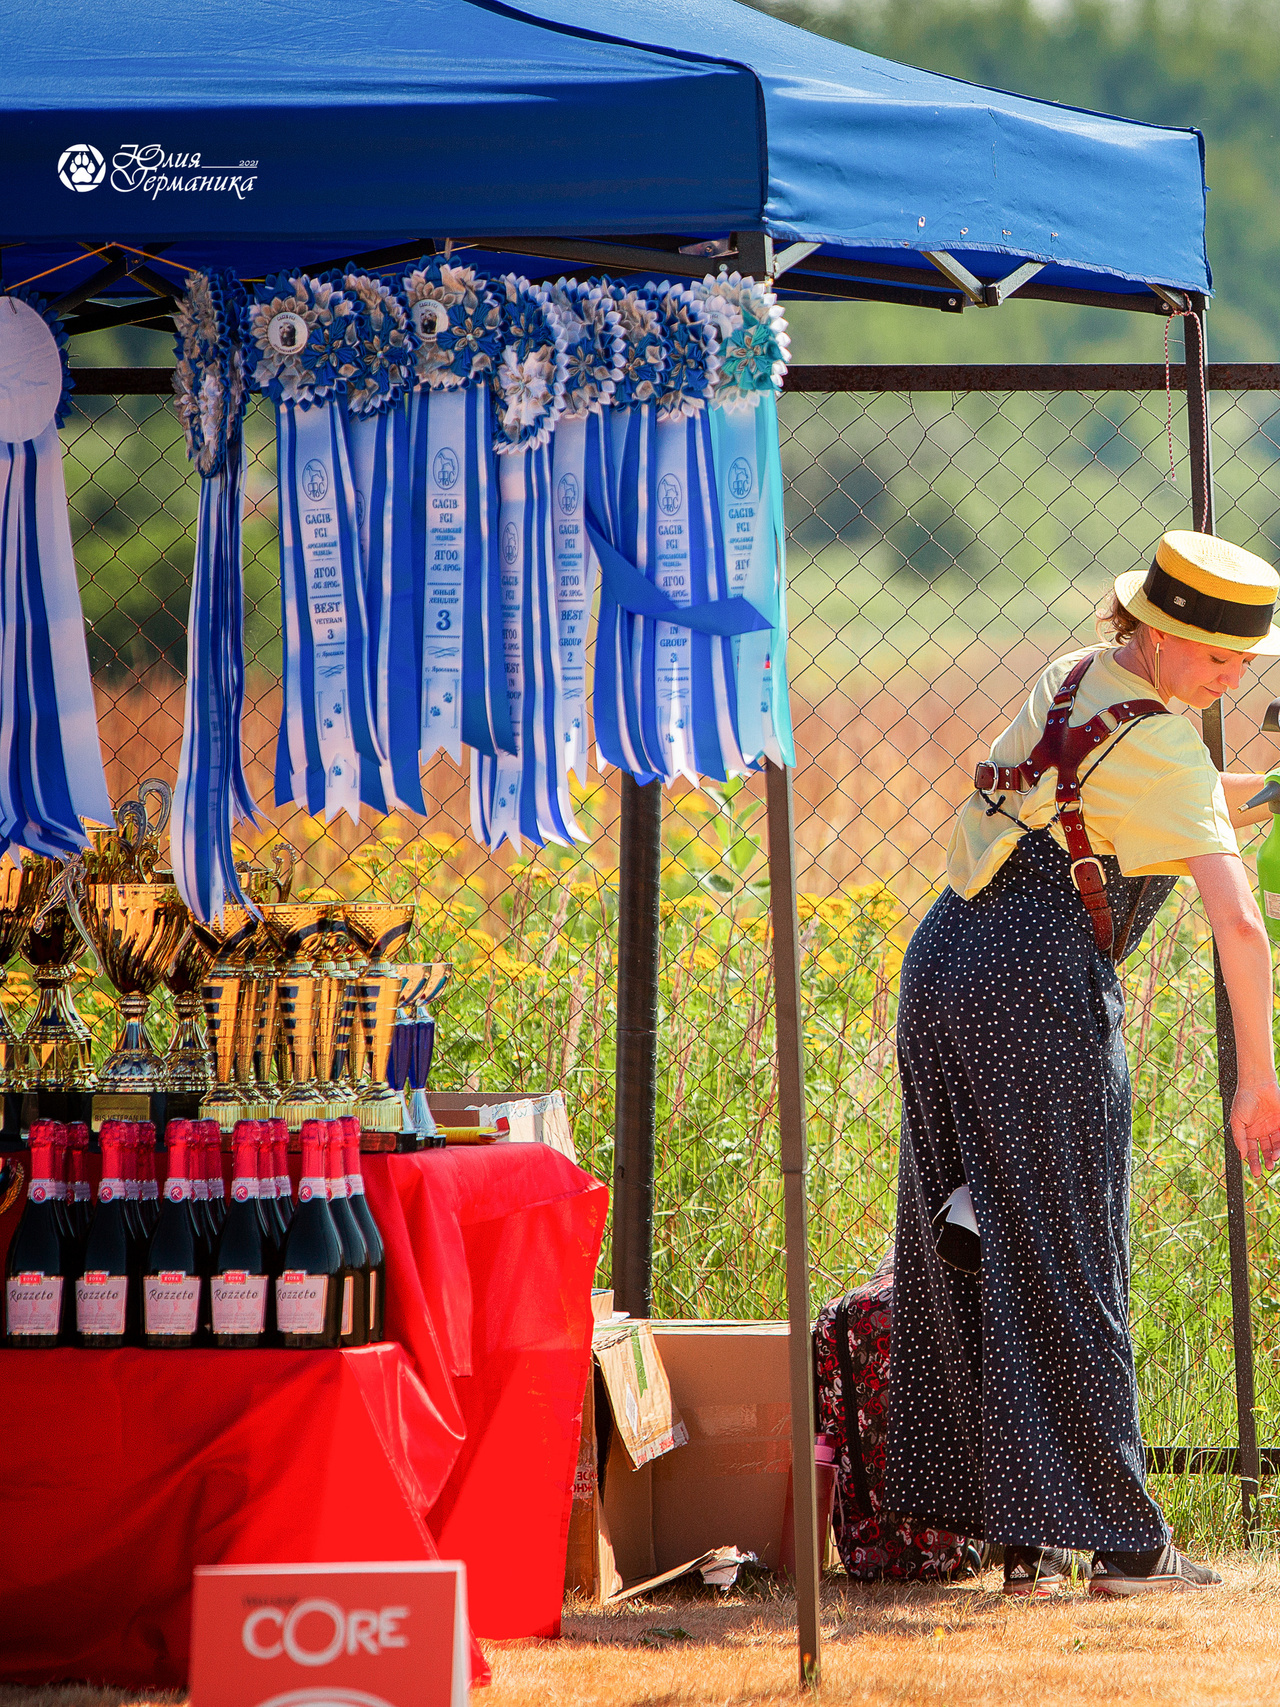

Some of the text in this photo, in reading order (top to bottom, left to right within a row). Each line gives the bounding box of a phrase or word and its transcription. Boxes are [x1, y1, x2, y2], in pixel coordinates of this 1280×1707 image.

[439, 513, 453, 523] FCI
[736, 522, 750, 532] FCI
[314, 528, 327, 538] FCI
[666, 538, 678, 549] FCI
[433, 550, 458, 561] ЯГОО
[314, 567, 336, 578] ЯГОО
[561, 575, 580, 587] ЯГОО
[662, 575, 685, 587] ЯГОО
[433, 588, 455, 596] ЮНЫЙ
[314, 602, 341, 614] BEST
[436, 609, 451, 631] 3
[561, 609, 583, 621] BEST
[315, 617, 343, 625] VETERAN
[327, 629, 334, 640] 3
[567, 625, 576, 634] IN
[669, 626, 678, 634] IN
[559, 637, 582, 647] GROUP
[660, 638, 687, 647] GROUP
[567, 651, 573, 663] 2
[669, 652, 677, 663] 3
[9, 1288, 54, 1302] Rozzeto
[77, 1288, 120, 1302] Rozzeto
[149, 1288, 195, 1302] Rozzeto
[213, 1288, 260, 1302] Rozzeto
[241, 1596, 412, 1668] CORE
